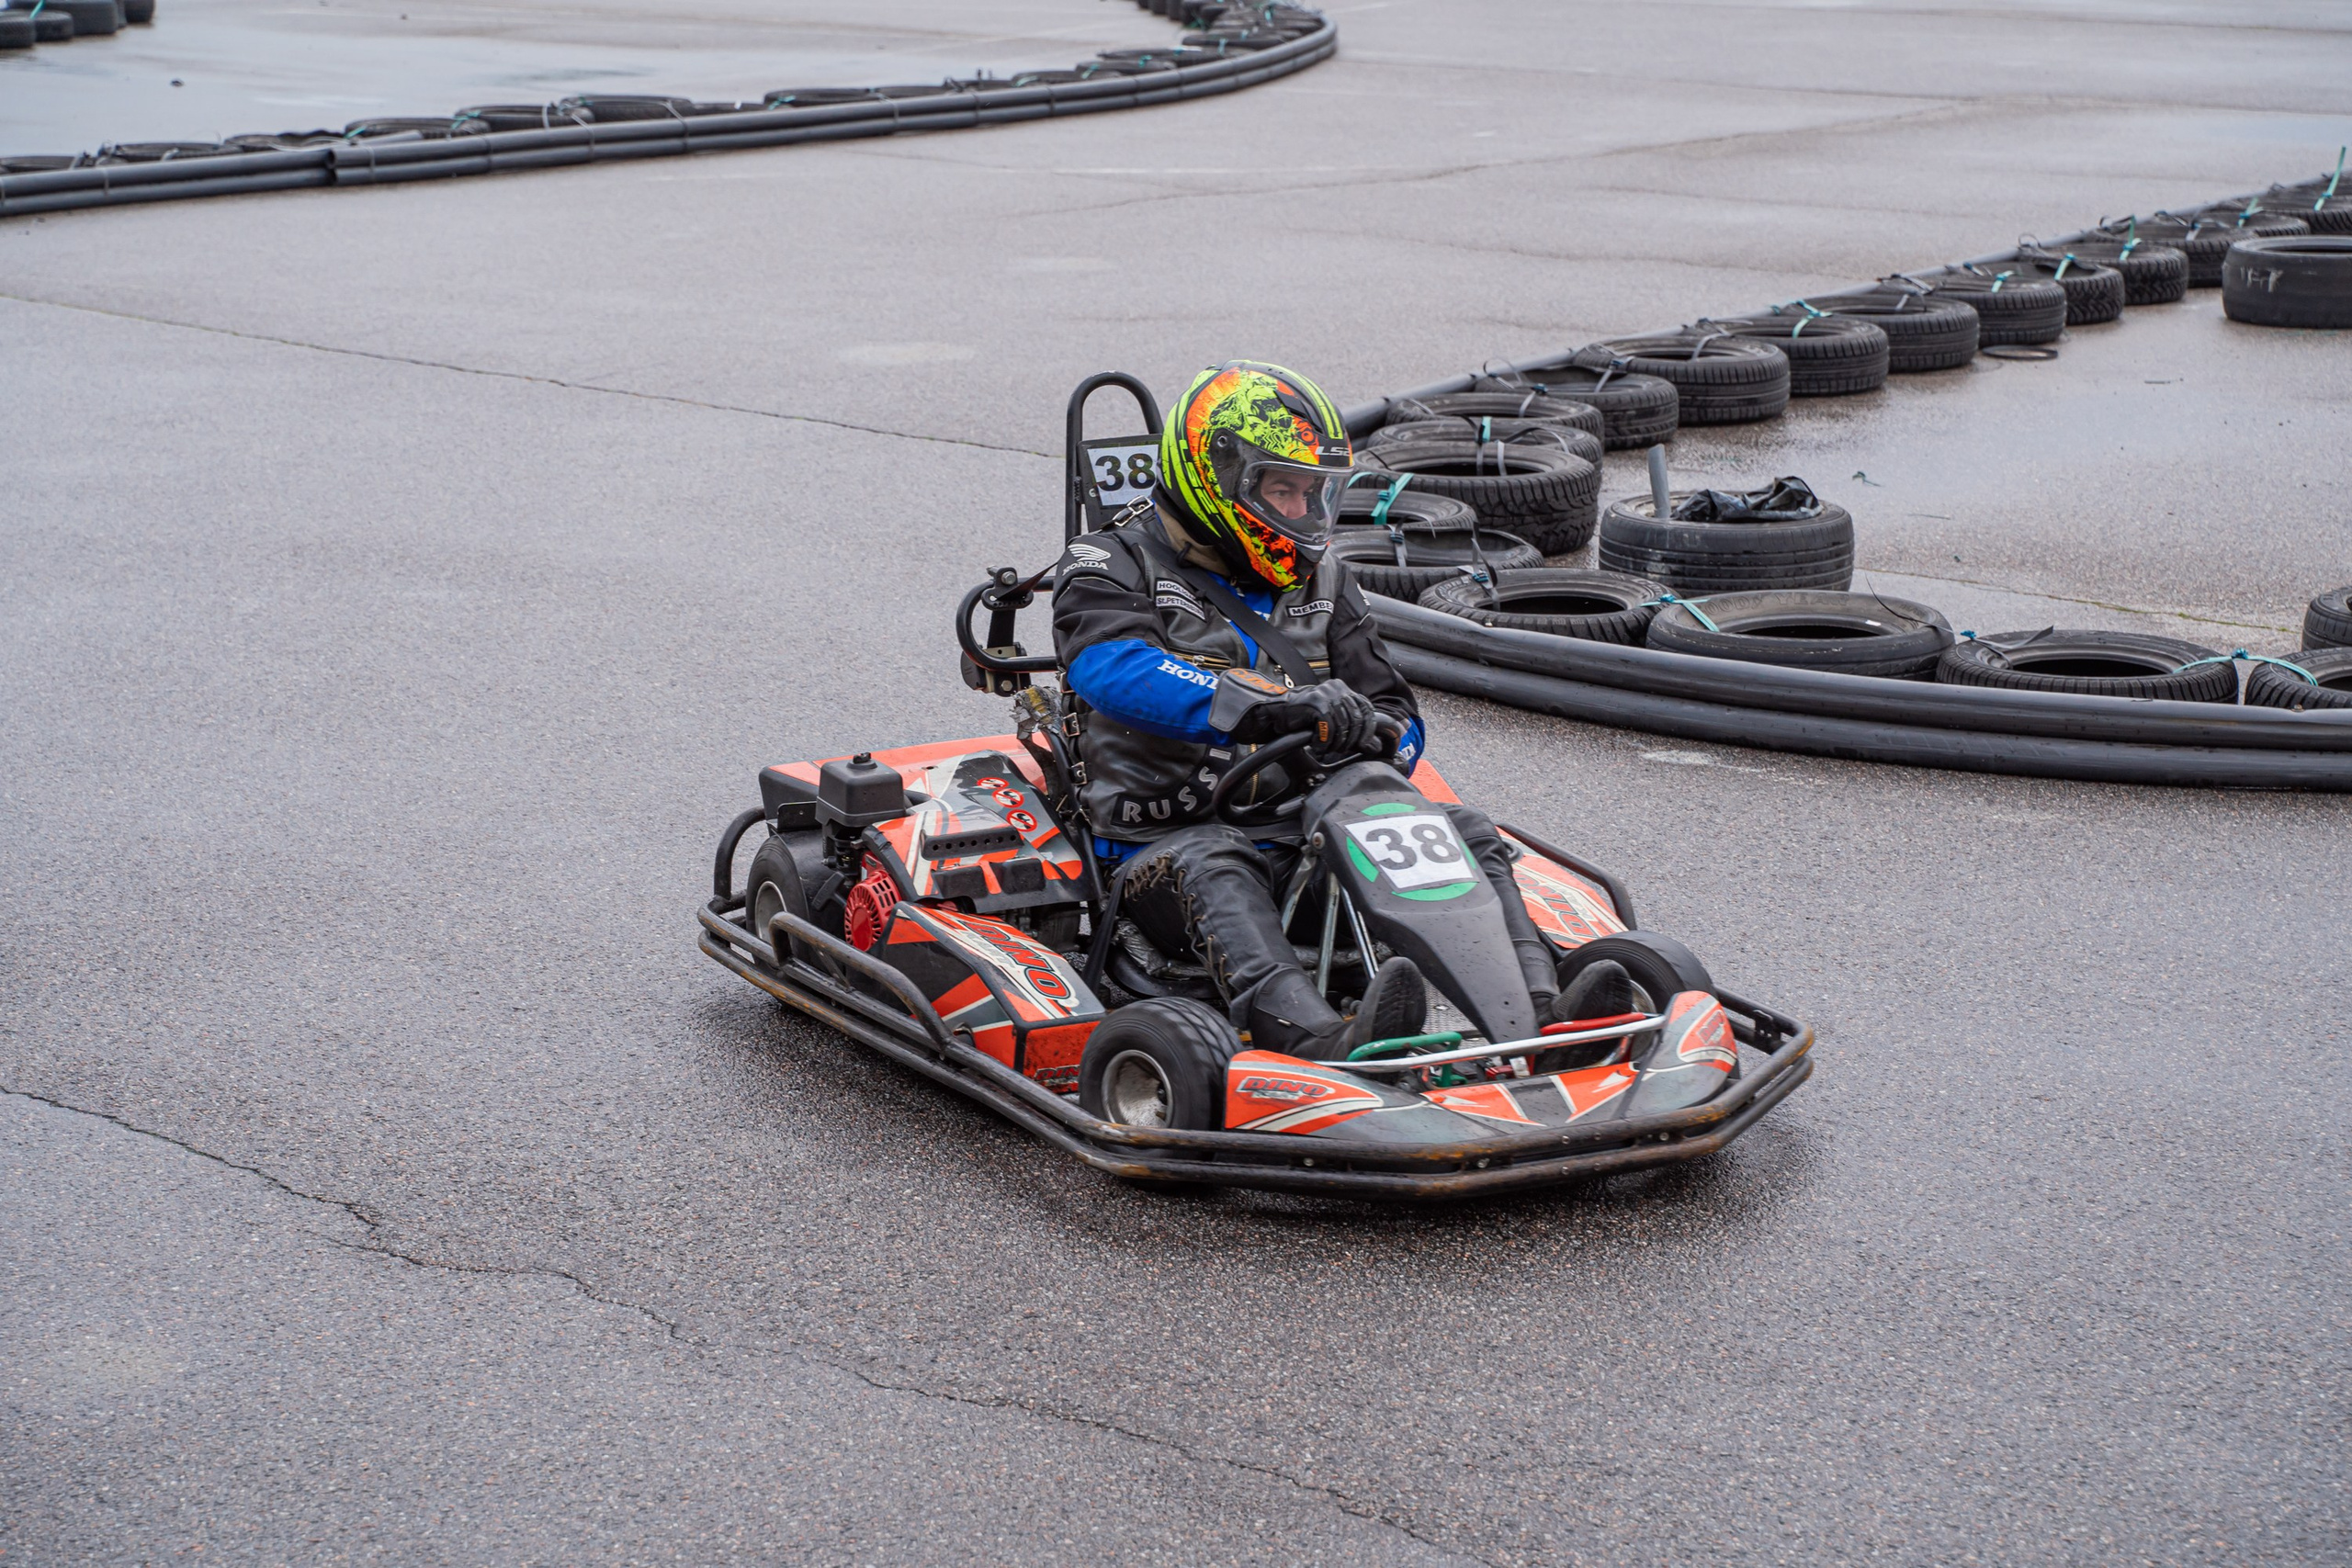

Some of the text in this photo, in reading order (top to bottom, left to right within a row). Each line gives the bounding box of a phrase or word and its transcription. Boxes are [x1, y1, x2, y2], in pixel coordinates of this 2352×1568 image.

[1094, 453, 1156, 491] 38
[1179, 440, 1219, 514] LS2
[1062, 561, 1109, 576] HONDA
[1365, 823, 1462, 871] 38
[957, 919, 1071, 999] DINO
[1240, 1077, 1329, 1096] DINO
